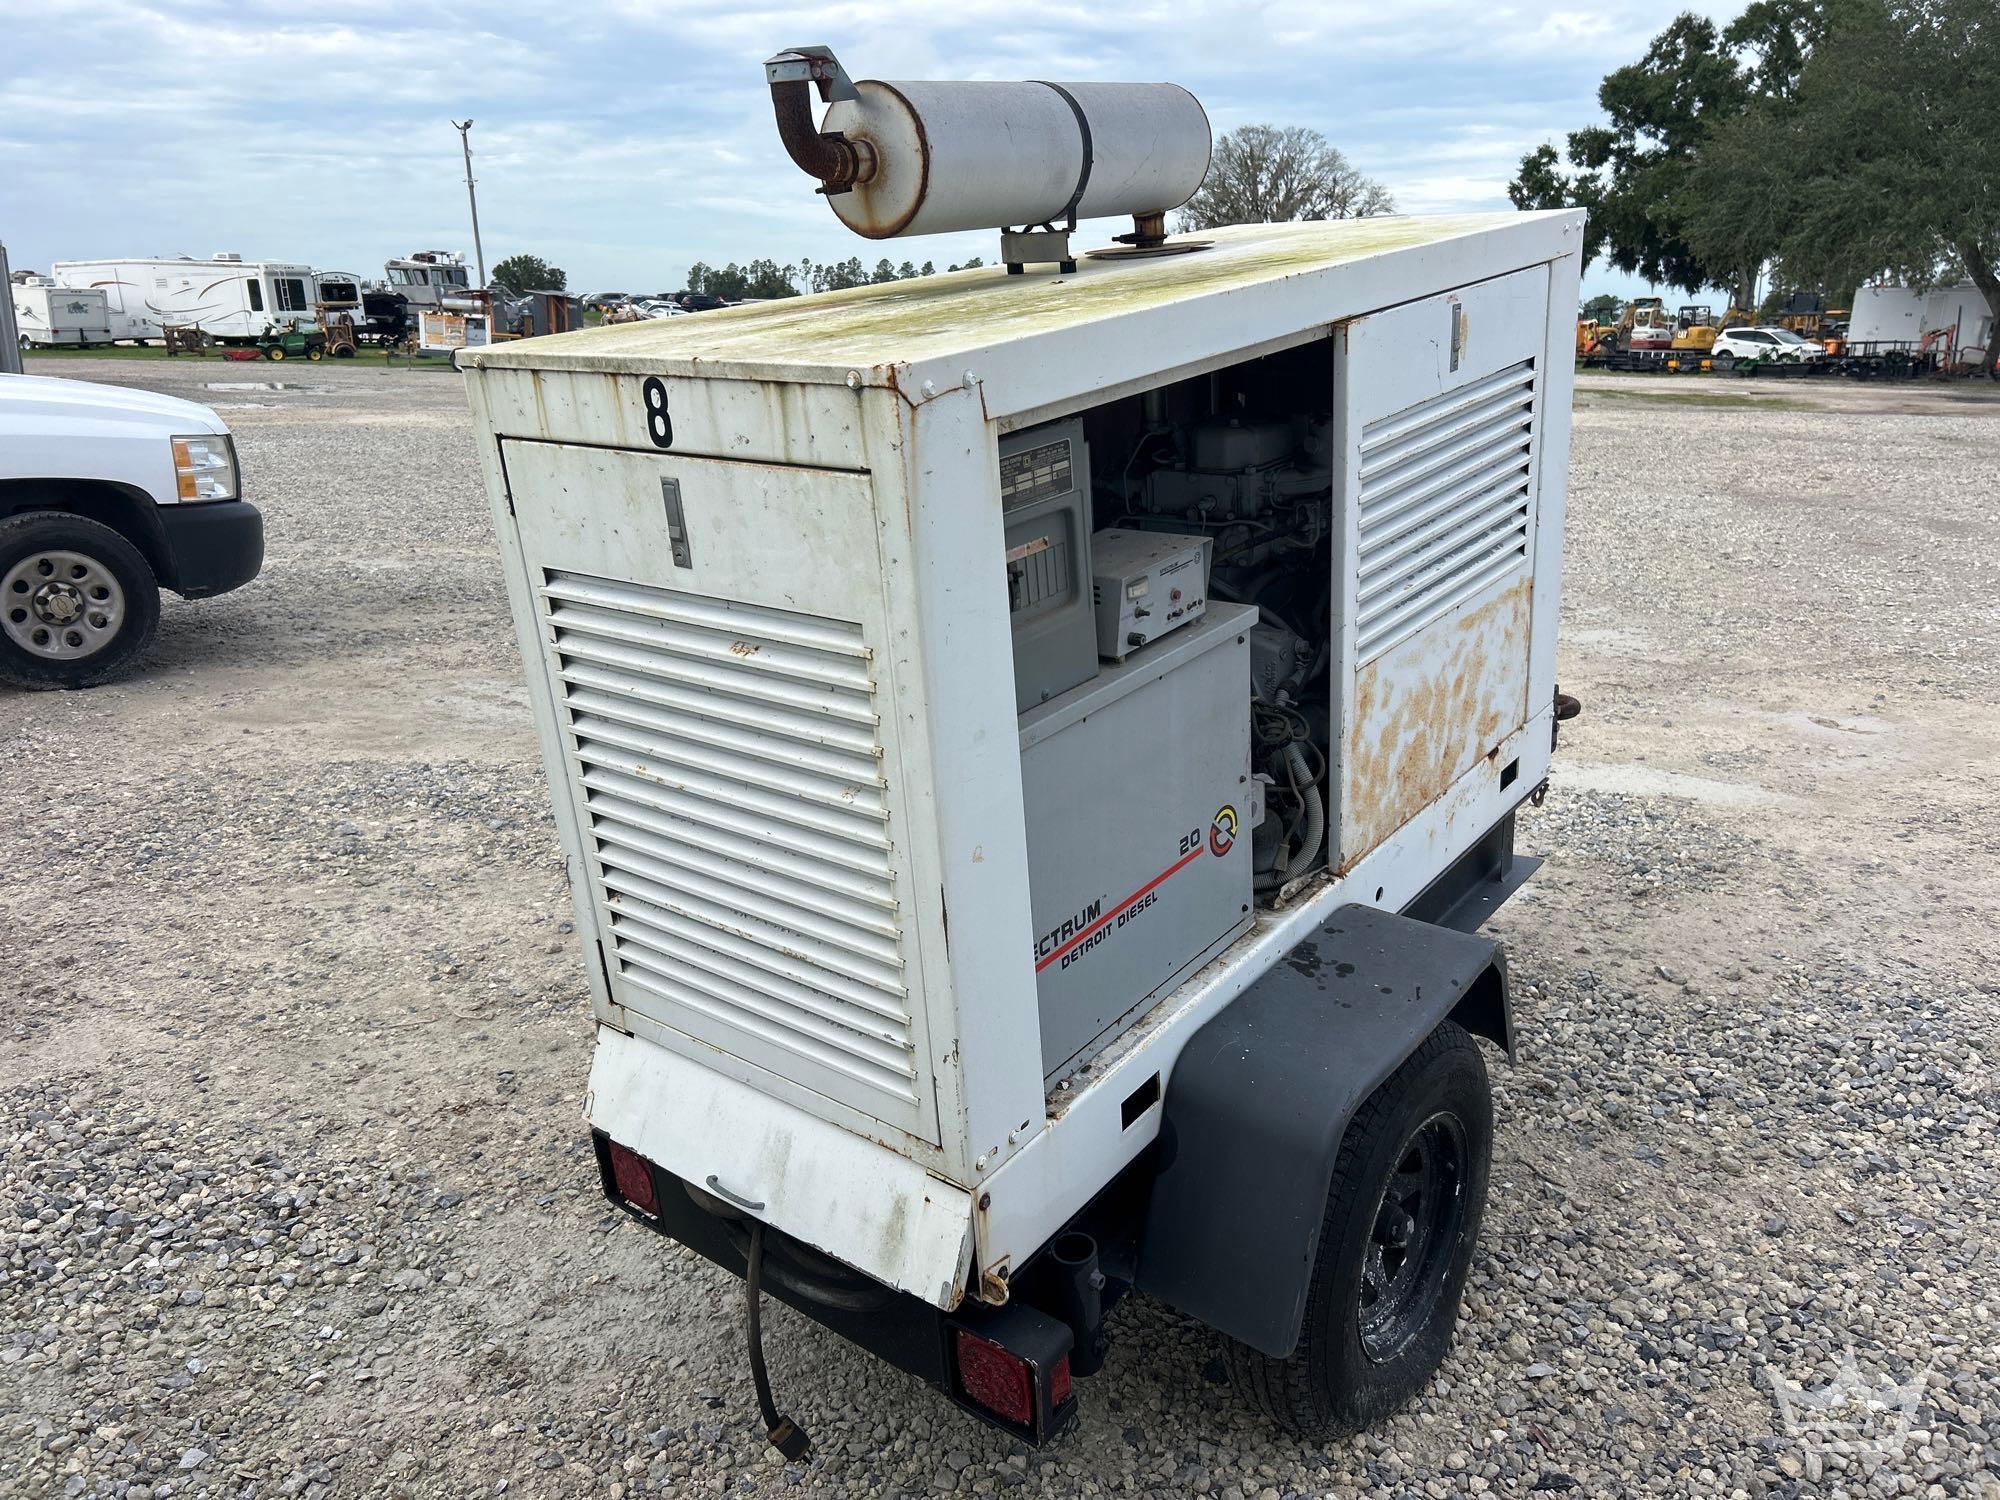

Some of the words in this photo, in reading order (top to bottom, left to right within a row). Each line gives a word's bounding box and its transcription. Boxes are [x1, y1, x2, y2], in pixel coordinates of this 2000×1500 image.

[1677, 330, 1687, 339] CAT
[643, 376, 673, 449] 8
[1179, 827, 1201, 856] 20
[1061, 922, 1113, 970] DETROIT
[1117, 891, 1158, 928] DIESEL
